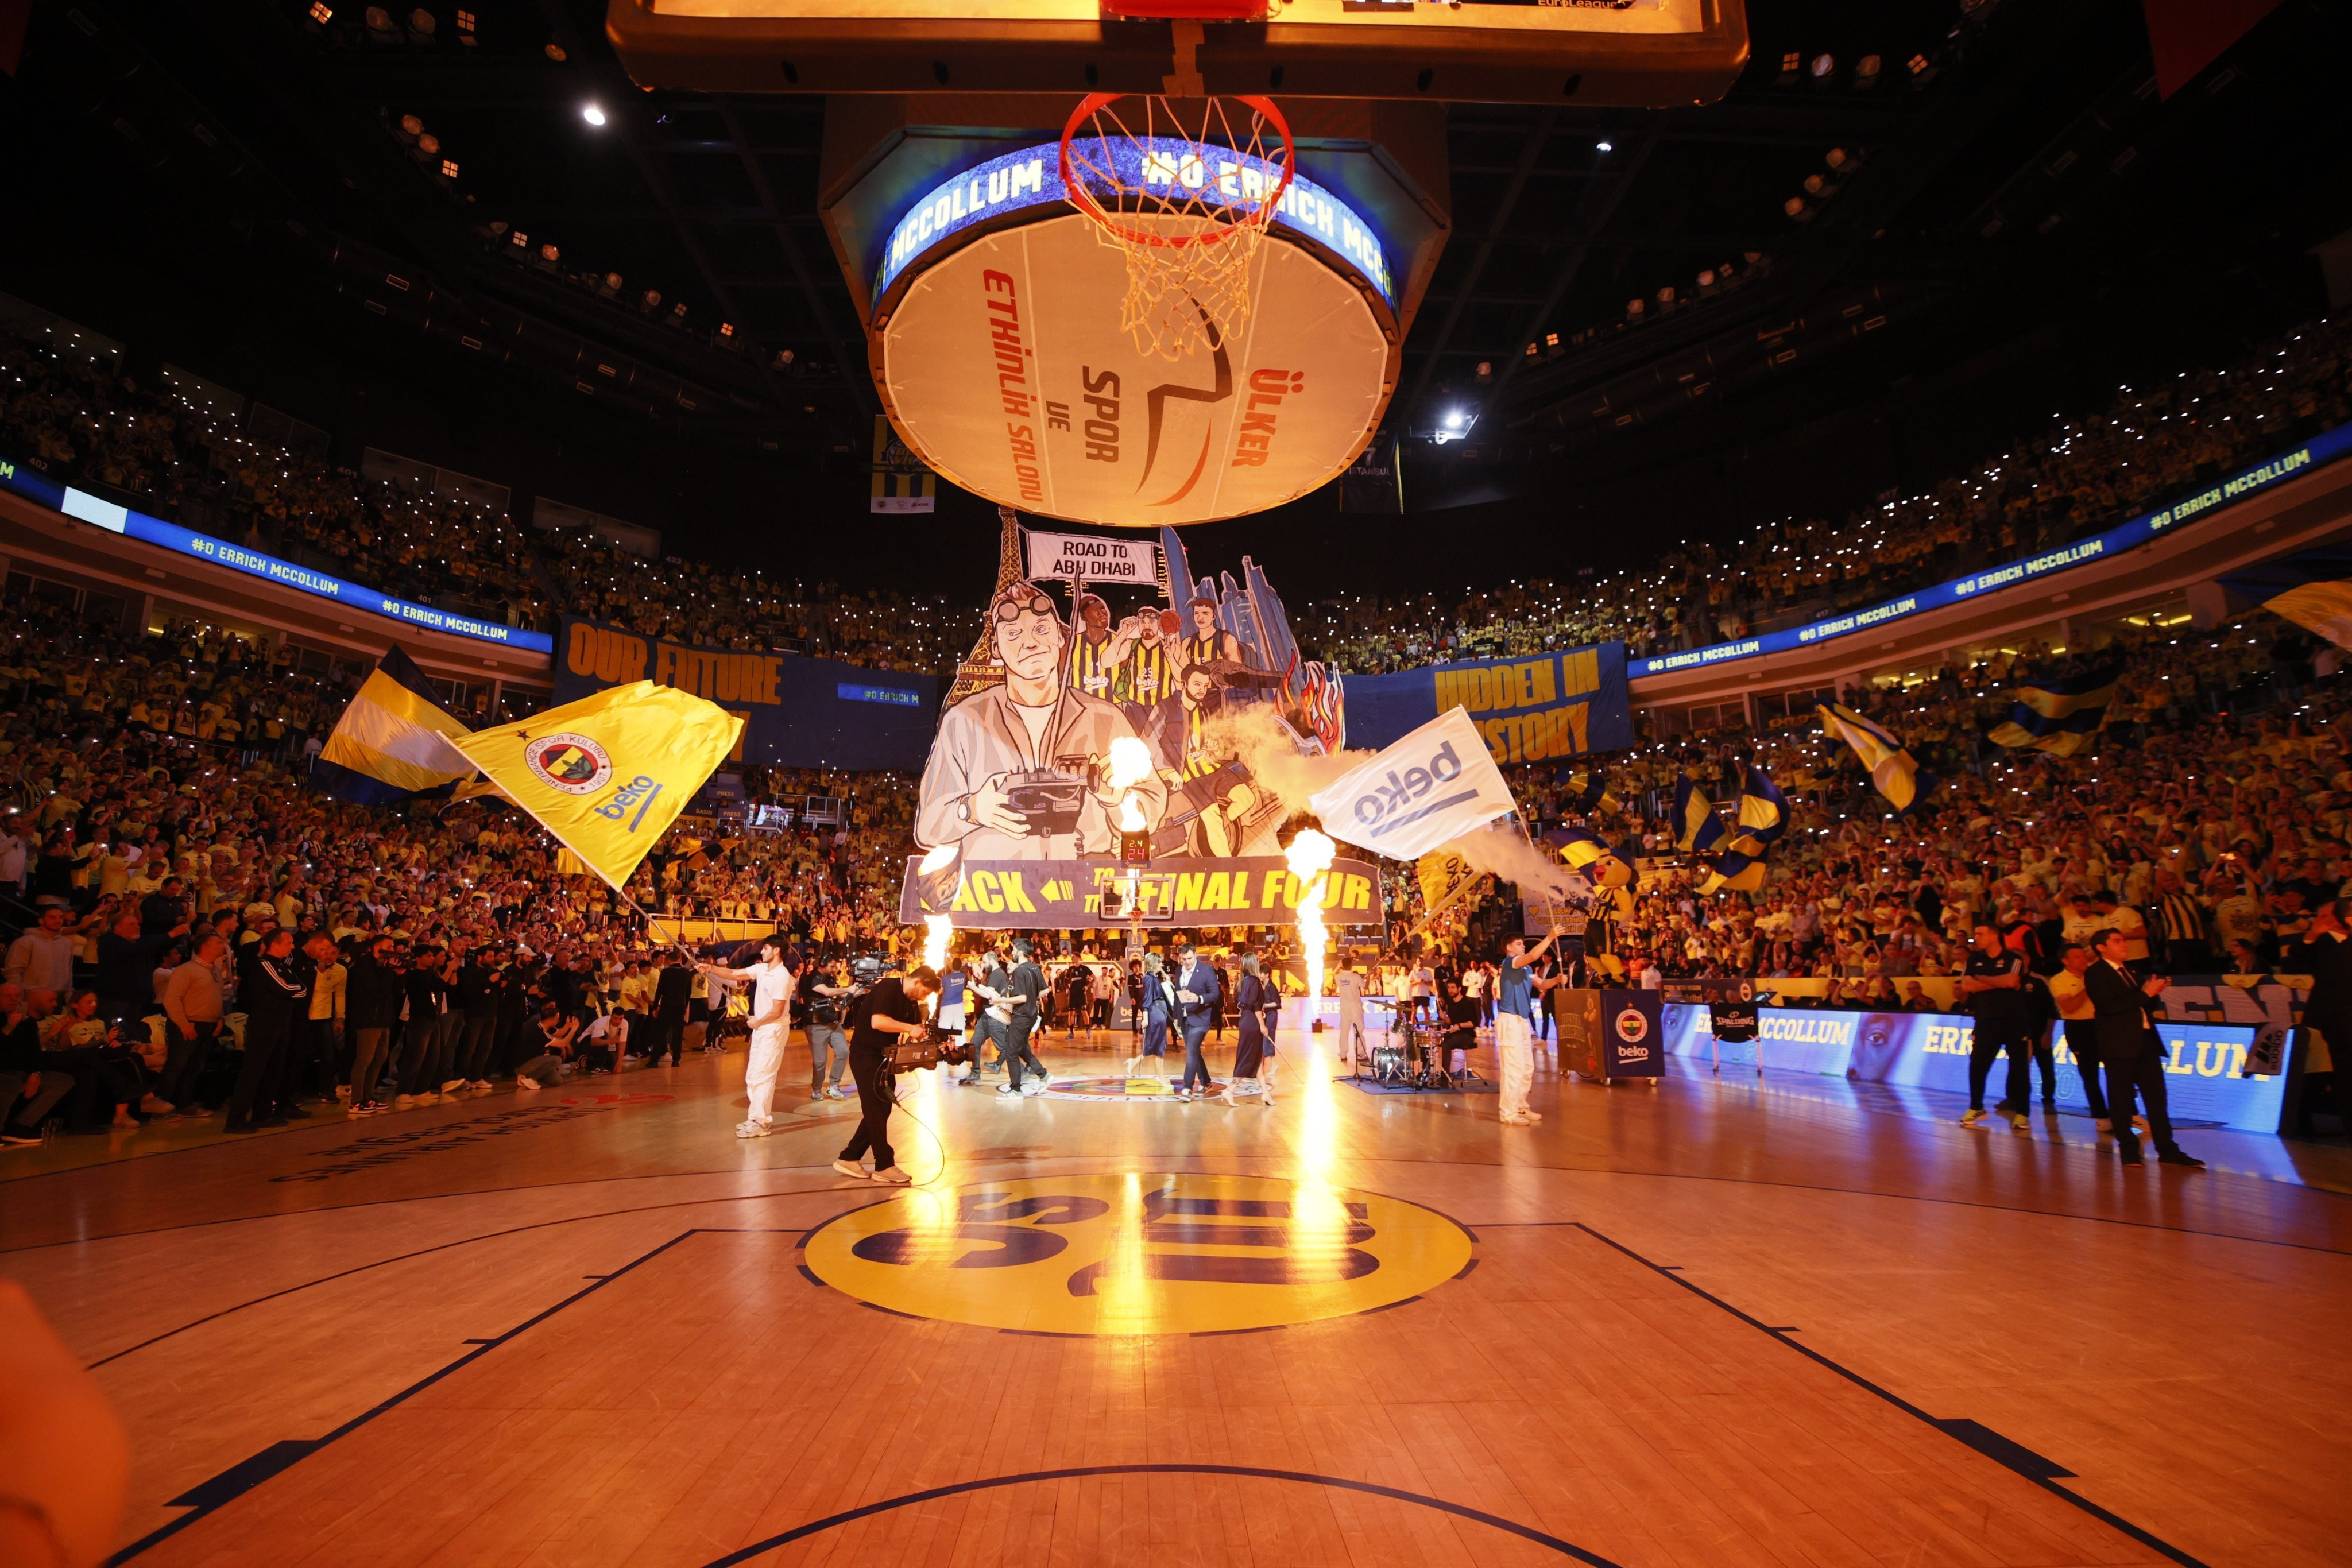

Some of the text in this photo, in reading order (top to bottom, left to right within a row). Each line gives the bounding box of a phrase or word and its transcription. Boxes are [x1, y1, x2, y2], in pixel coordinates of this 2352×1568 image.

[1141, 152, 1204, 188] #0
[891, 158, 1042, 271] MCCOLLUM
[1082, 366, 1120, 463] SPOR
[1231, 369, 1304, 467] ÜLKER
[29, 458, 48, 471] 402
[1007, 422, 1043, 502] SALONU
[2150, 449, 2311, 529] #0 ERRICK MCCOLLUM
[192, 538, 339, 595] #0 ERRICK MCCOLLUM
[1053, 559, 1135, 576] ABU DHABI
[1063, 541, 1128, 559] ROAD TO
[1955, 540, 2103, 595] #0 ERRICK MCCOLLUM
[418, 594, 431, 603] 401
[383, 599, 508, 640] #0 ERRICK MCCOLLUM
[1799, 598, 1916, 642] #0 ERRICK MCCOLLUM
[567, 622, 783, 705] OUR FUTURE
[1089, 661, 1101, 675] 11
[1141, 667, 1154, 678] 23
[1647, 641, 1759, 671] #0 ERRICK MCCOLLUM
[1083, 676, 1109, 685] beko
[1136, 677, 1159, 686] beko
[1435, 648, 1600, 715] HIDDEN IN
[535, 735, 565, 749] SPOR
[1473, 701, 1589, 766] STORY
[589, 772, 608, 788] 1907
[594, 776, 654, 820] beko
[1128, 849, 1145, 860] 24
[922, 869, 1037, 913] ACK
[1716, 1017, 1754, 1026] SPALDING
[1618, 1046, 1649, 1056] beko
[268, 1136, 485, 1183] AIRLINES
